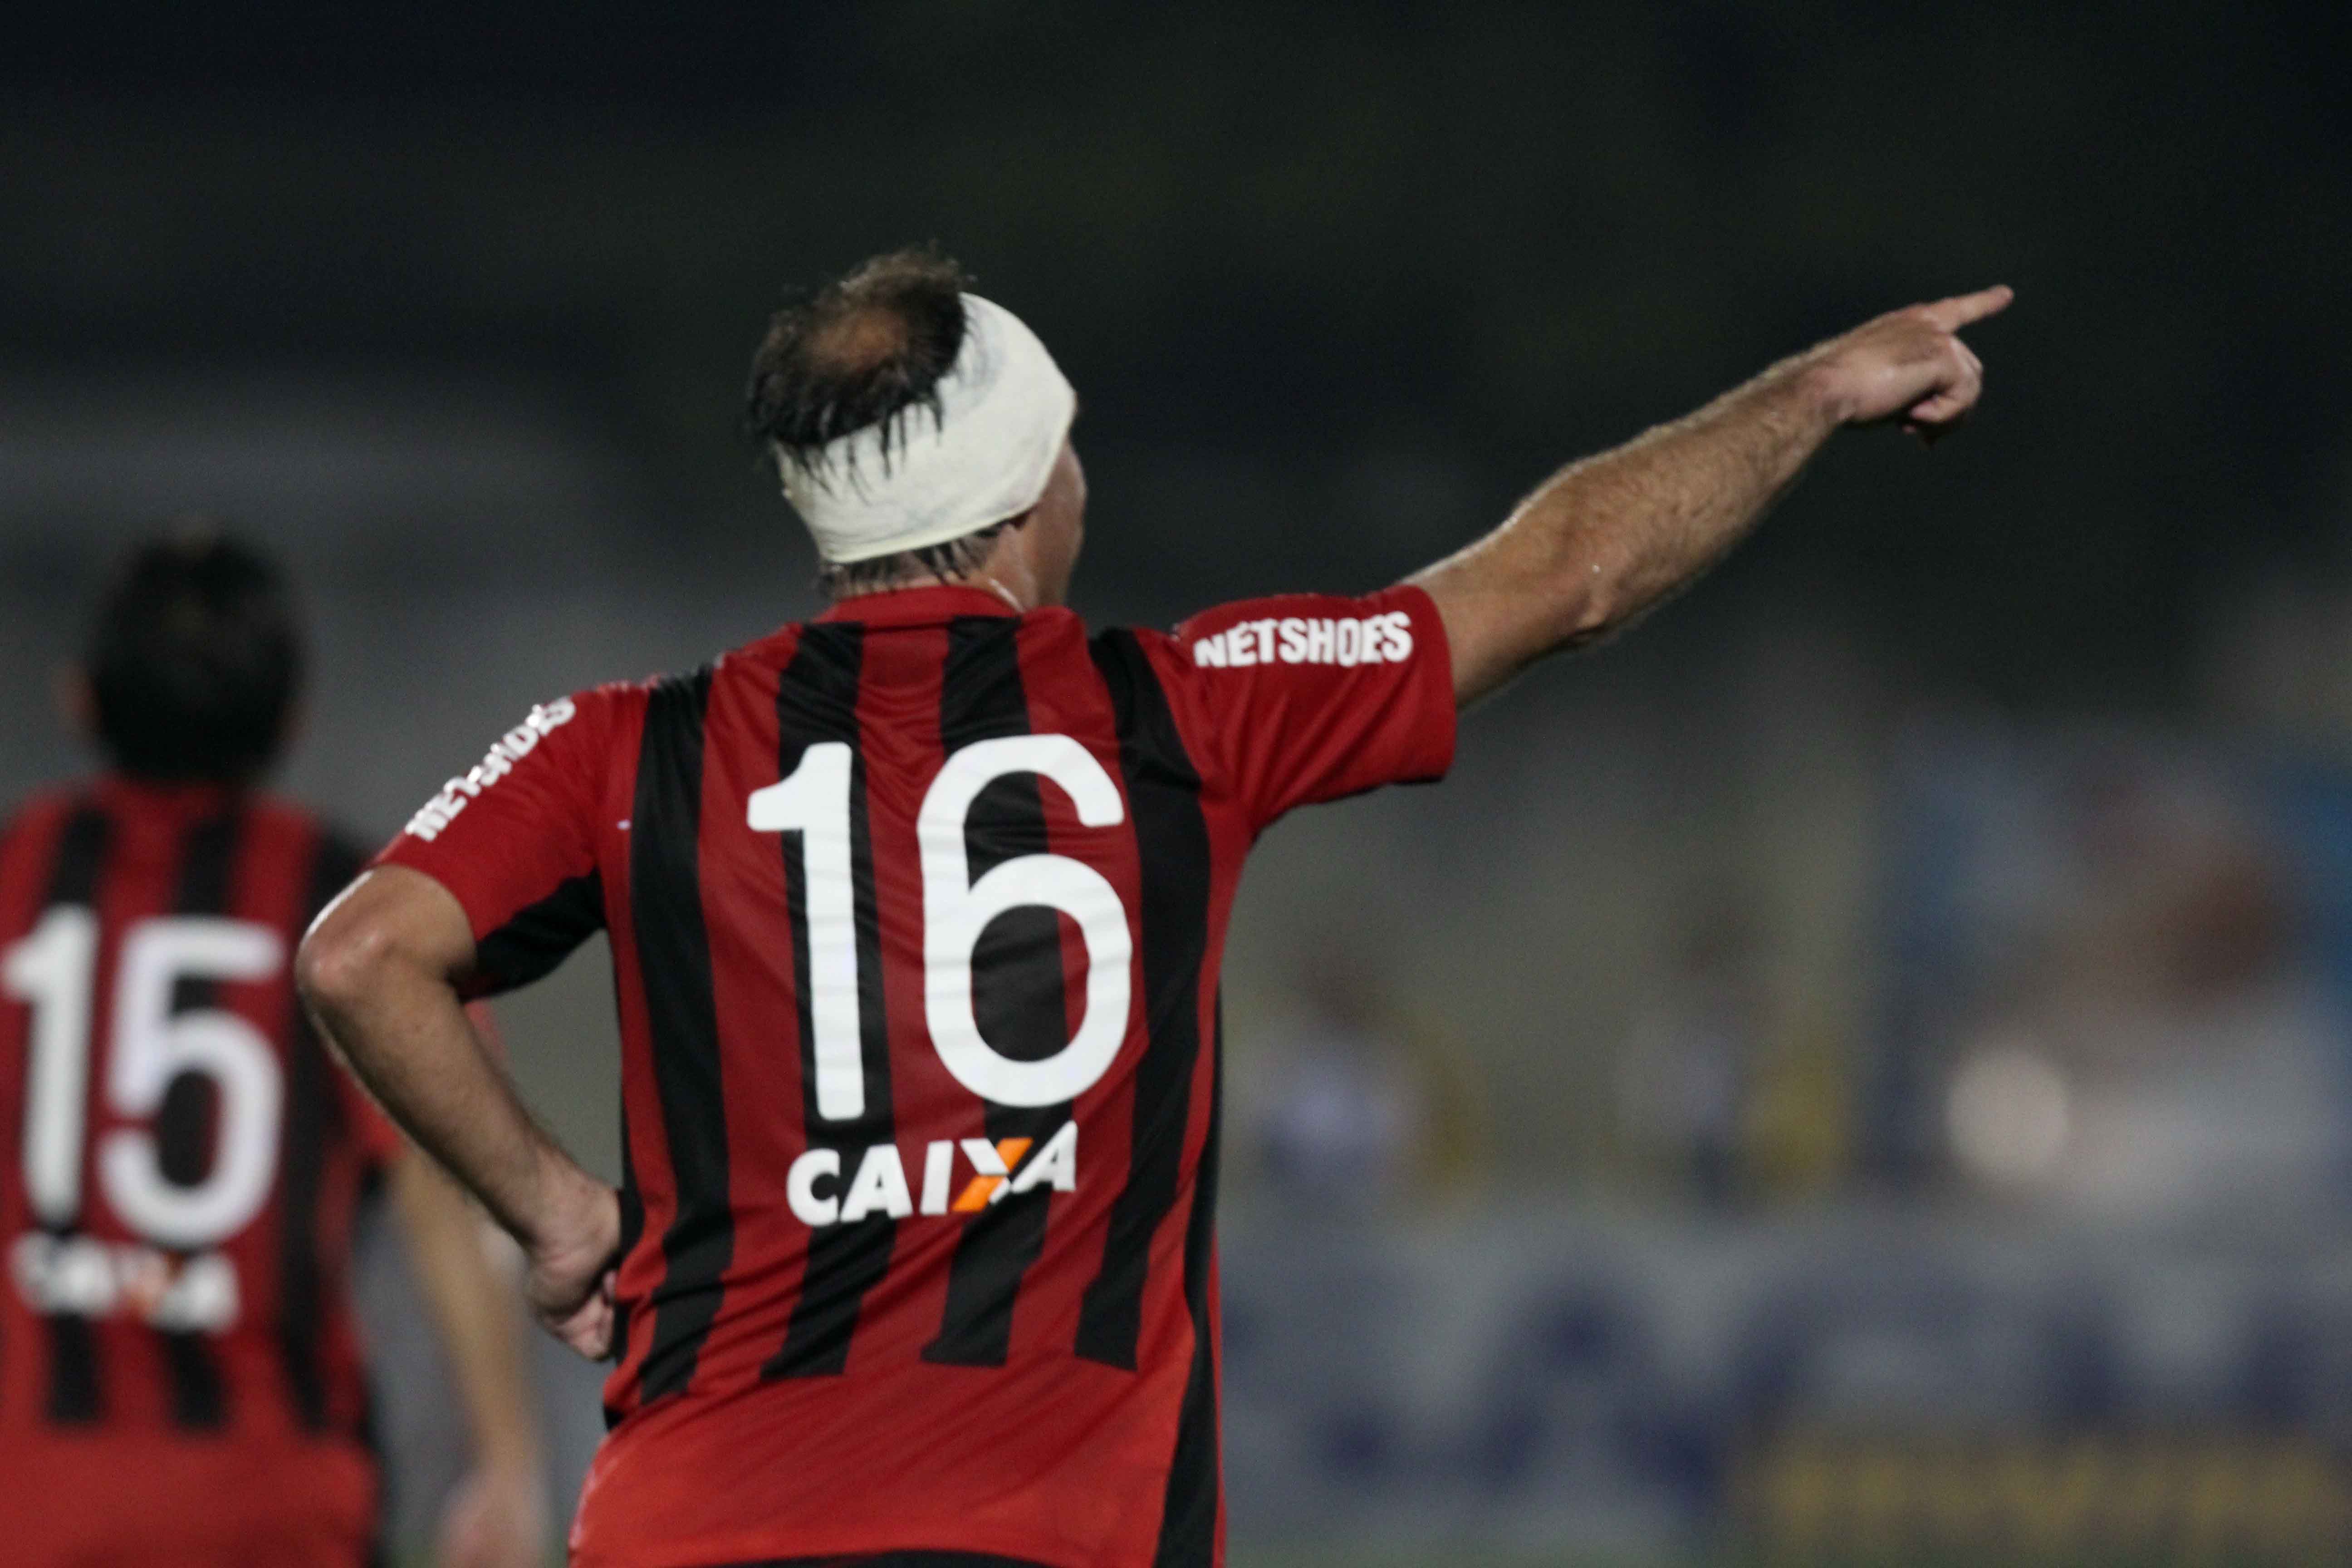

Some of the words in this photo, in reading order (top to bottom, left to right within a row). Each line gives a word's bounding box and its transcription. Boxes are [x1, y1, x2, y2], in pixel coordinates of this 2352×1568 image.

[1194, 611, 1413, 667] NETSHOES
[748, 734, 1132, 1121] 16
[2, 904, 284, 1248] 15
[788, 1121, 1078, 1225] CAIXA
